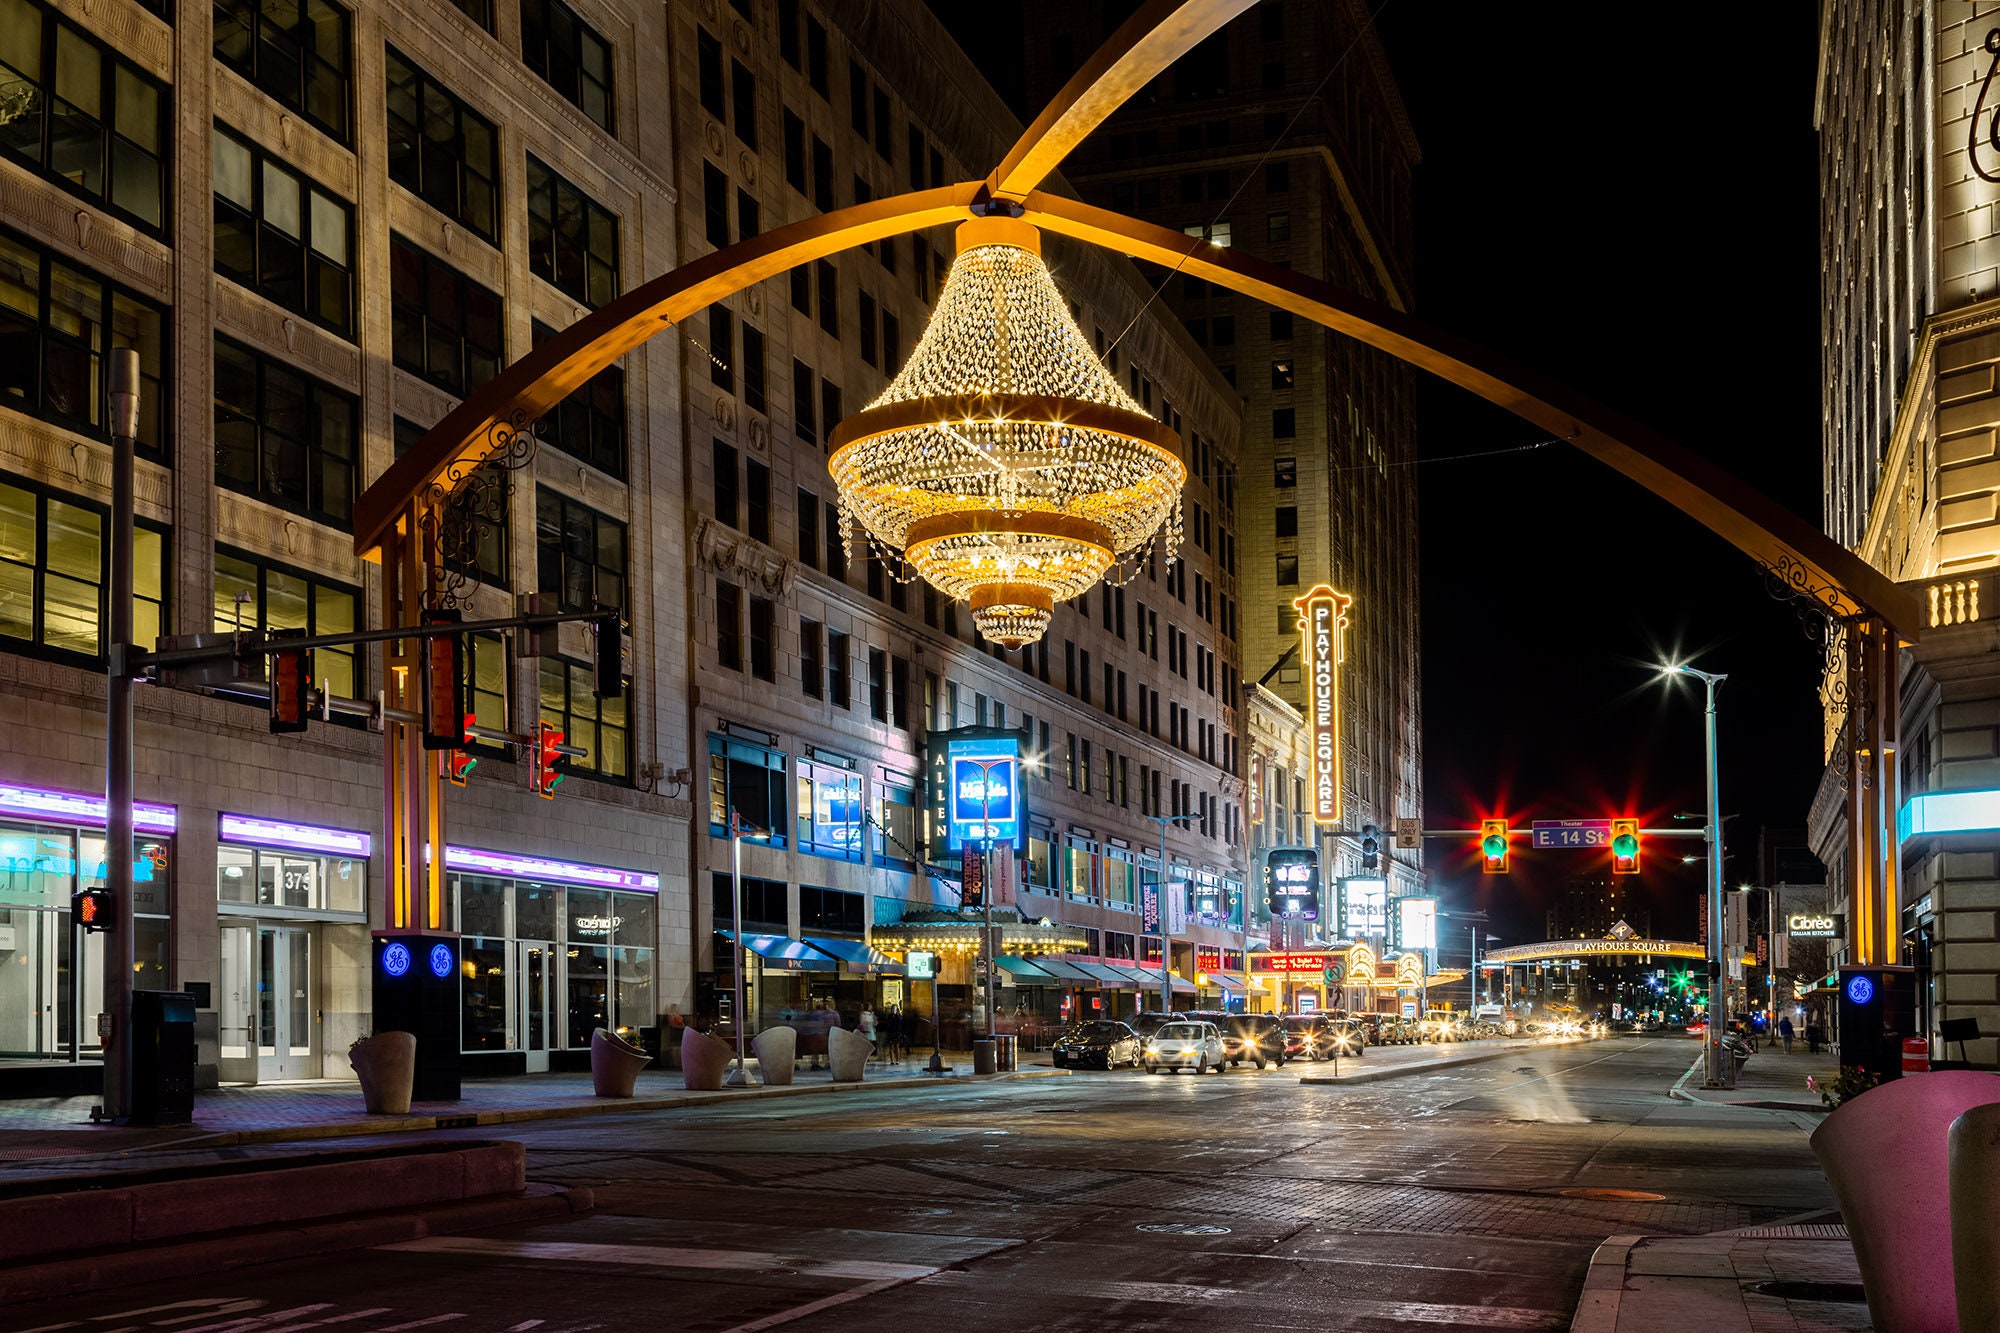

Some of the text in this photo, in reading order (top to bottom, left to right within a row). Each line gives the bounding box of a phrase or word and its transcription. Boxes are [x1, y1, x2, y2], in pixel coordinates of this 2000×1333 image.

[1315, 608, 1333, 814] PLAYHOUSE SQUARE
[935, 753, 947, 837] ALLEN
[1400, 828, 1416, 836] ONLY
[1401, 820, 1415, 828] BUS
[1539, 829, 1605, 845] E. 14 St
[964, 843, 972, 904] PLAYHOUSE
[972, 853, 982, 894] SQUARE
[1262, 866, 1271, 905] OHIO
[1143, 885, 1151, 932] PLAYHOUSE
[1150, 892, 1158, 925] SQUARE
[1699, 893, 1707, 943] PLAYHOUSE
[1790, 915, 1834, 930] Cibrèo
[1574, 942, 1671, 953] PLAYHOUSE SQUARE
